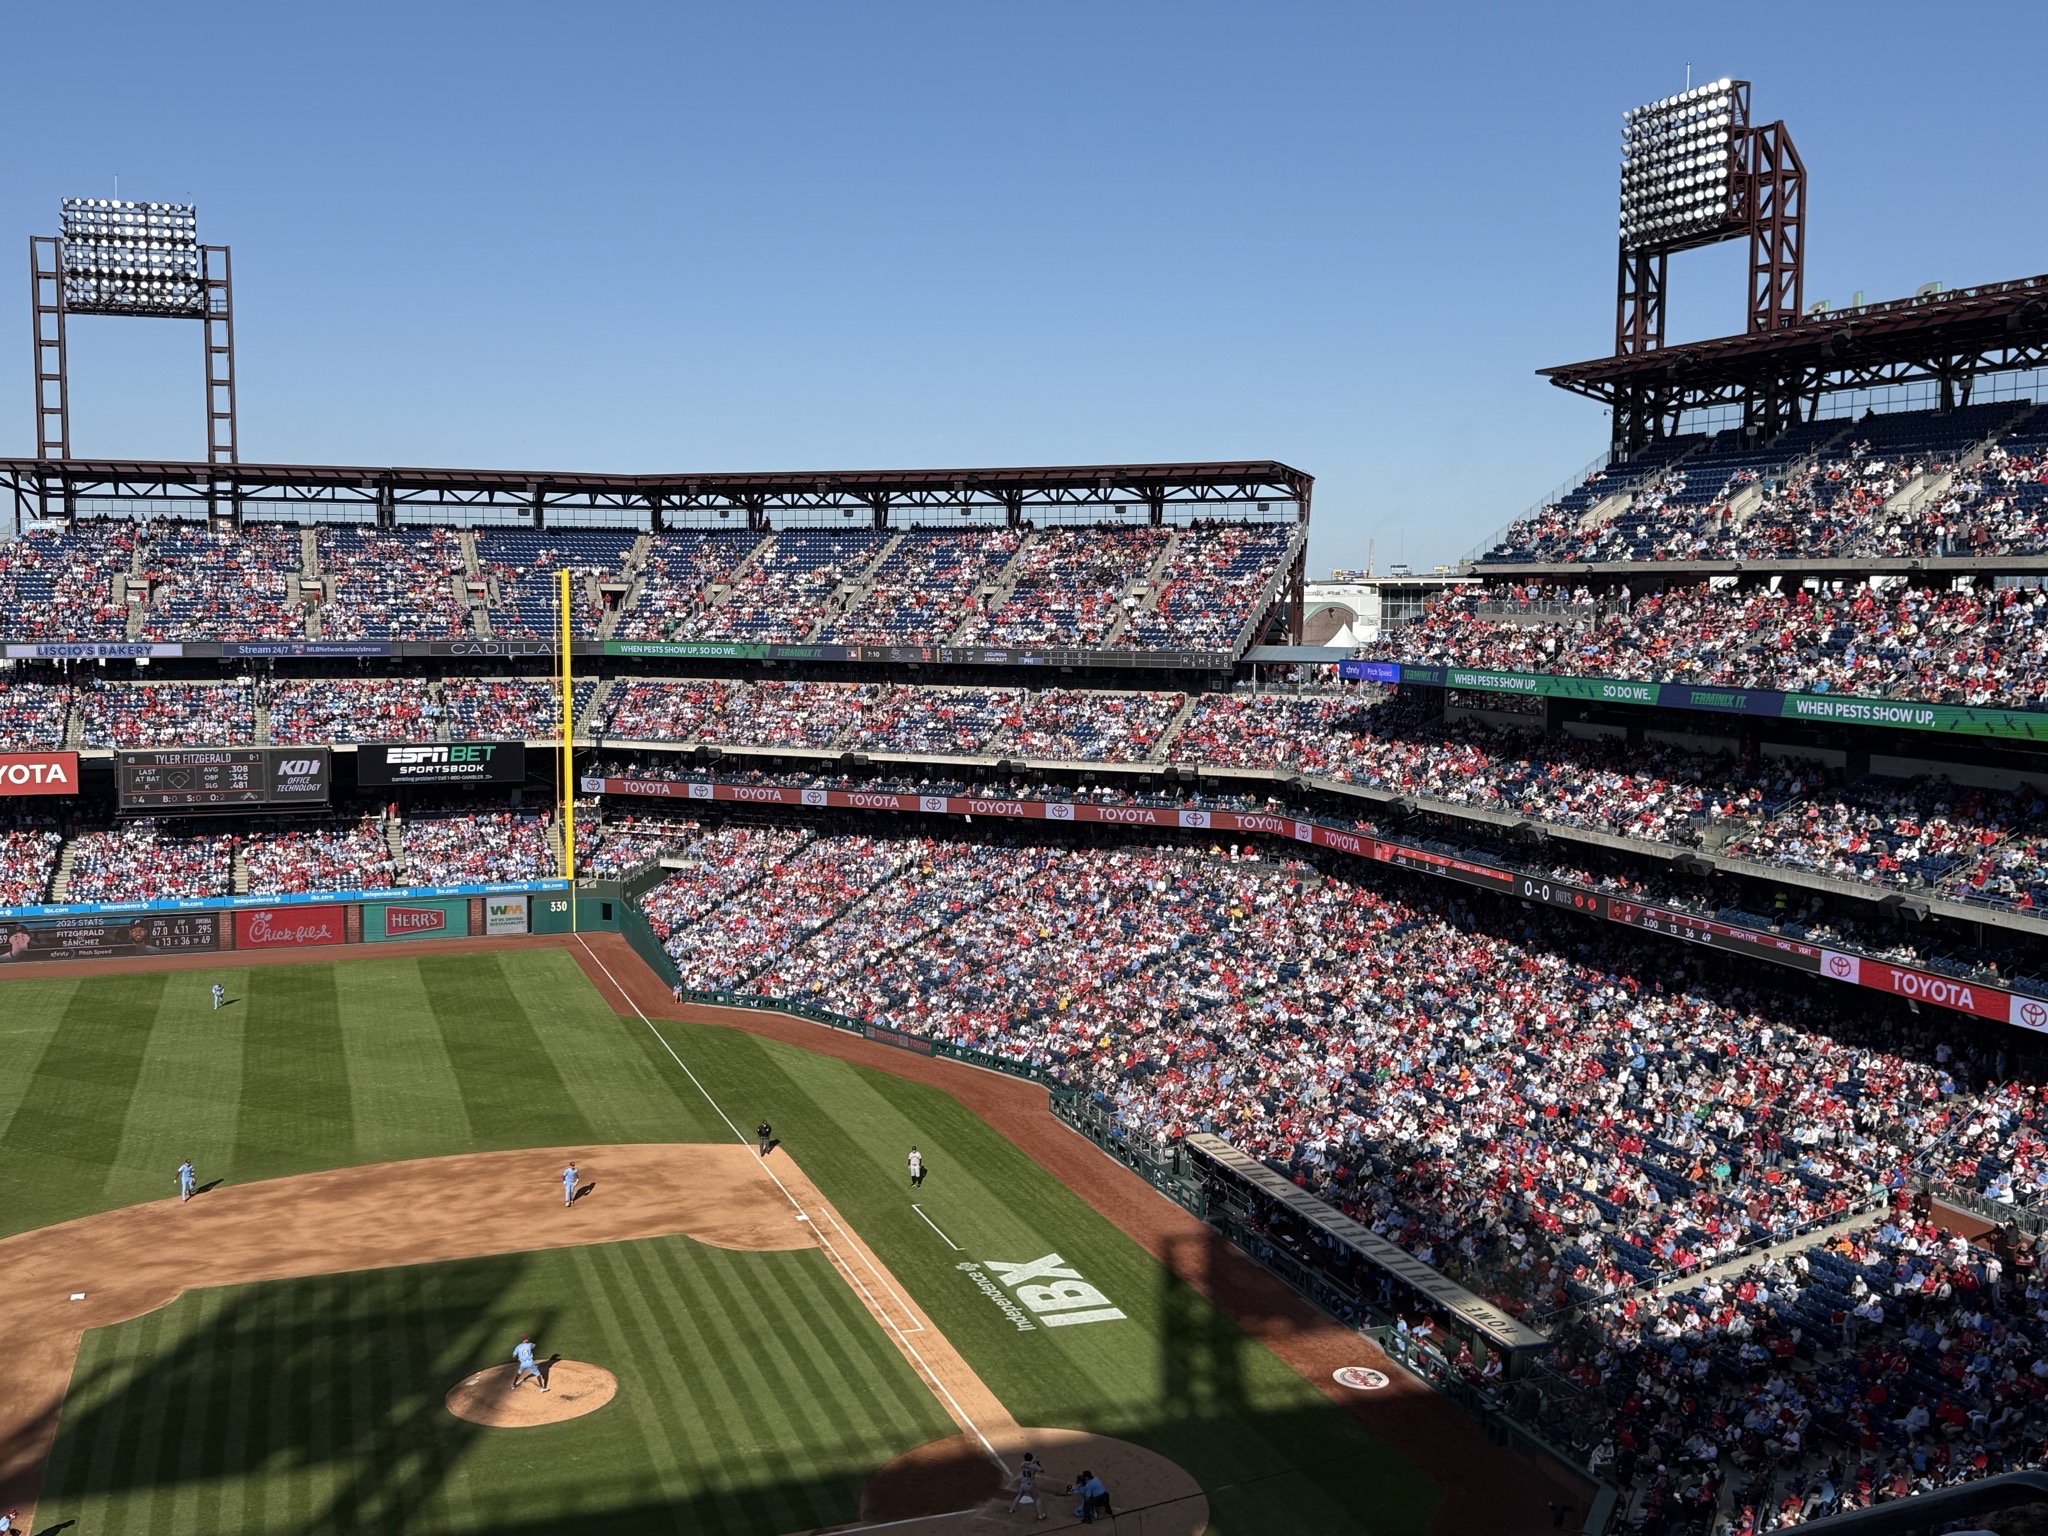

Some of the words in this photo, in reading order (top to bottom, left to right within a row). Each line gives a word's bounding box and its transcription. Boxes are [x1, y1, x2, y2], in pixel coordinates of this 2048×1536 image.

[37, 645, 95, 656] LISCIO'S
[98, 645, 153, 656] BAKERY
[239, 646, 272, 654] Stream
[272, 646, 288, 654] 24/7
[621, 645, 642, 653] WHEN
[664, 646, 686, 654] SHOW
[688, 646, 698, 655] UP,
[711, 647, 722, 655] DO
[723, 647, 737, 655] WE.
[777, 648, 812, 657] TERMINIX
[813, 649, 822, 657] IT.
[1345, 665, 1359, 675] xfinity
[1367, 668, 1377, 676] Pitch
[1378, 669, 1392, 678] Speed
[1403, 669, 1430, 681] TERMINIX
[1455, 673, 1477, 685] WHEN
[1477, 674, 1499, 687] PESTS
[1500, 676, 1524, 689] SHOW
[1525, 678, 1537, 692] UP,
[1603, 685, 1617, 697] SO
[1618, 686, 1632, 698] DO
[1633, 687, 1651, 700] WE.
[1690, 691, 1733, 708] TERMINIX
[1735, 695, 1746, 709] IT.
[1796, 700, 1833, 716] WHEN
[1835, 702, 1870, 720] PESTS
[1872, 706, 1913, 723] SHOW
[1915, 709, 1936, 728] UP,
[127, 756, 135, 764] 49
[155, 754, 181, 765] TYLER
[183, 753, 231, 764] FITZGERALD
[386, 747, 448, 764] ESPN
[450, 745, 496, 761] BET
[229, 765, 248, 773] .308
[277, 760, 321, 775] KDI
[400, 764, 484, 774] SPORTSBOOK
[277, 783, 321, 792] TECHNOLOGY
[287, 776, 310, 785] OFFICE
[623, 781, 671, 795] TOYOTA
[732, 787, 782, 801] TOYOTA
[163, 795, 178, 803] B:0
[187, 794, 201, 802] S:0
[847, 794, 899, 808] TOYOTA
[968, 800, 1023, 815] TOYOTA
[1097, 808, 1155, 823] TOYOTA
[1235, 815, 1284, 833] TOYOTA
[1324, 831, 1360, 852] TOYOTA
[485, 883, 523, 891] Independence
[1524, 881, 1549, 900] 0-0
[1555, 890, 1572, 905] OUTS
[490, 904, 523, 915] WM
[550, 901, 567, 912] 330
[78, 918, 104, 926] STATS
[390, 912, 438, 928] HERR'S
[57, 929, 104, 938] FITZGERALD
[152, 927, 168, 936] 67.0
[174, 925, 189, 934] 4.11
[196, 925, 212, 933] .295
[250, 917, 332, 943] Chick-fil-A
[1625, 914, 1631, 922] 61
[1643, 918, 1658, 929] 3.00
[1670, 924, 1677, 934] 13
[1685, 928, 1694, 939] 36
[1702, 932, 1711, 943] 49
[1647, 909, 1655, 917] ERA
[1730, 929, 1744, 940] PITCH
[1745, 932, 1757, 942] TYPE
[1776, 941, 1791, 951] HORZ
[1798, 946, 1812, 956] VERT
[62, 939, 99, 947] SÁNCHEZ
[162, 937, 171, 946] 13
[181, 937, 190, 945] 36
[201, 936, 210, 944] 49
[1890, 970, 1975, 1010] TOYOTA
[877, 1030, 898, 1040] TOYOTA
[910, 1039, 931, 1050] TOYOTA
[1200, 1139, 1288, 1187] PHILLIES
[1284, 1192, 1459, 1293] PHILADELPHIA
[983, 1253, 1127, 1328] IBX
[969, 1266, 1036, 1332] Independence
[1464, 1307, 1518, 1335] HOME
